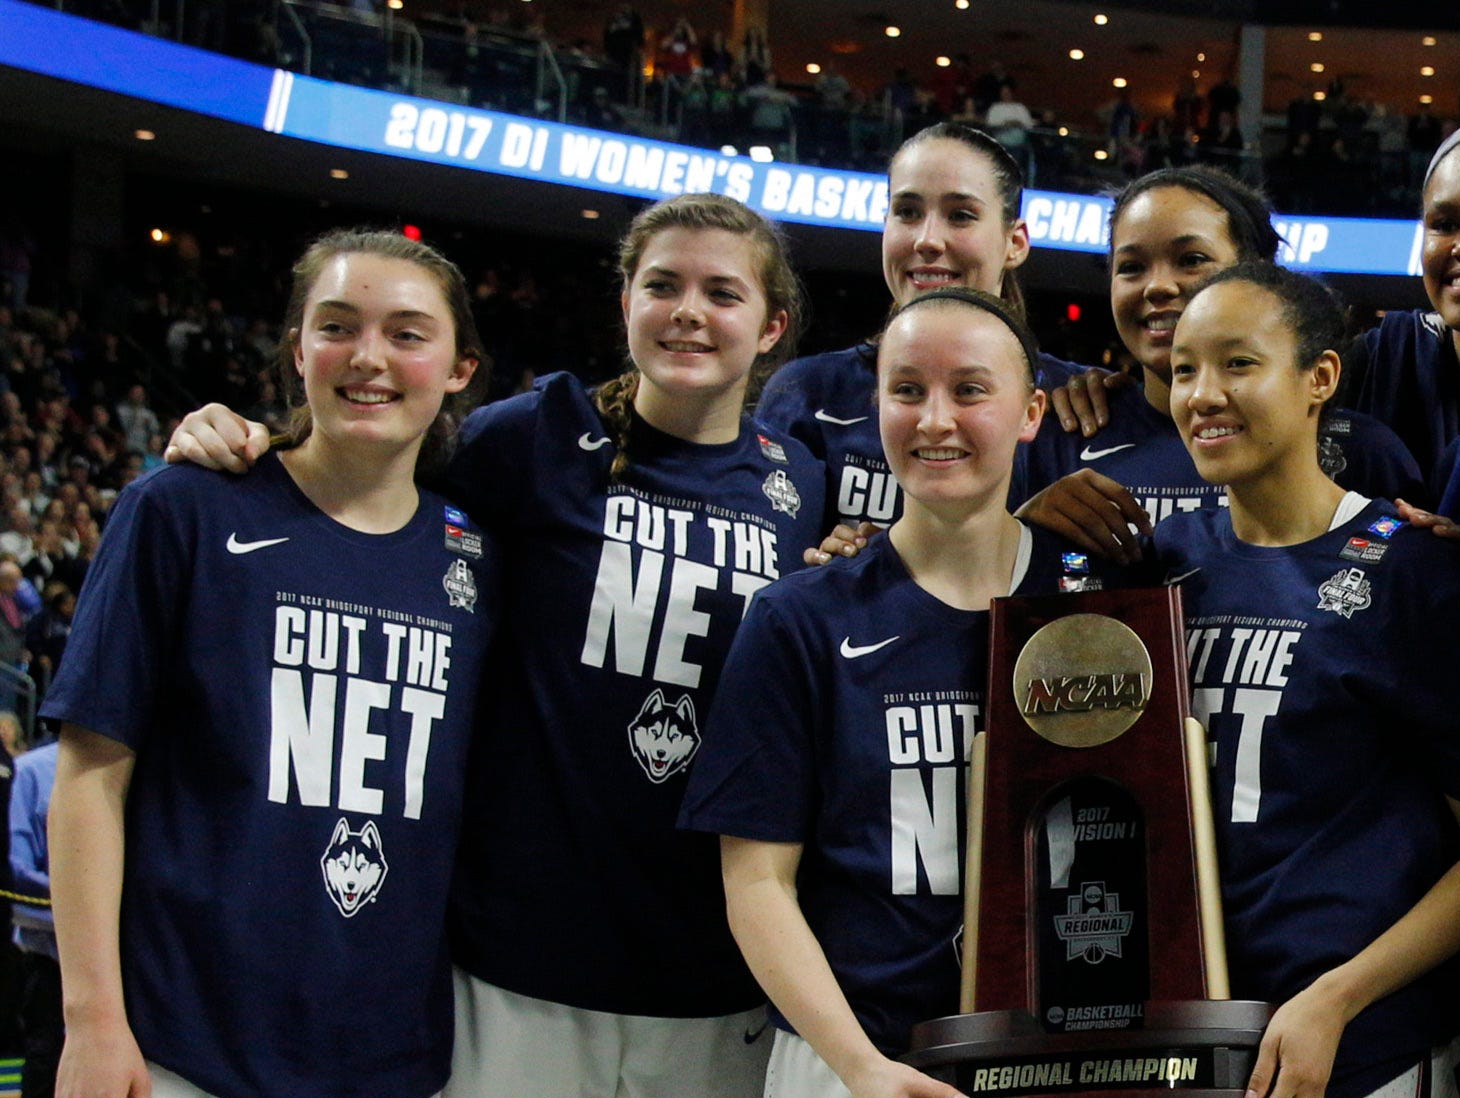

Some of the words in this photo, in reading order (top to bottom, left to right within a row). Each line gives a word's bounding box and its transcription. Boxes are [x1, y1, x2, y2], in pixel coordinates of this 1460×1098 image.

[385, 103, 492, 160] 2017
[500, 122, 550, 172] DI
[559, 131, 753, 200] WOMEN'S
[761, 168, 889, 224] BASKE
[838, 465, 898, 520] CU
[603, 495, 694, 557] CUT
[707, 516, 780, 580] THE
[276, 591, 296, 603] 2017
[300, 594, 322, 607] NCAA
[325, 598, 374, 617] BRIDGEPORT
[377, 608, 413, 624] REGIONAL
[416, 615, 453, 632] CHAMPIONS
[1266, 618, 1309, 630] CHAMPIONS
[273, 605, 367, 675] CUT
[382, 621, 452, 692] THE
[1222, 627, 1301, 688] THE
[883, 693, 904, 704] 2017
[908, 691, 932, 702] NCAA
[1024, 671, 1147, 717] NCAA
[267, 667, 446, 820] NET
[885, 703, 980, 765] CUT
[1070, 822, 1126, 842] VISION
[1076, 806, 1111, 823] 2017
[1064, 917, 1126, 934] REGIONAL
[1064, 1018, 1131, 1032] CHAMPIONSHIP
[1066, 1003, 1144, 1021] BASKETBALL
[973, 1062, 1074, 1093] REGIONAL
[1079, 1056, 1198, 1084] CHAMPION
